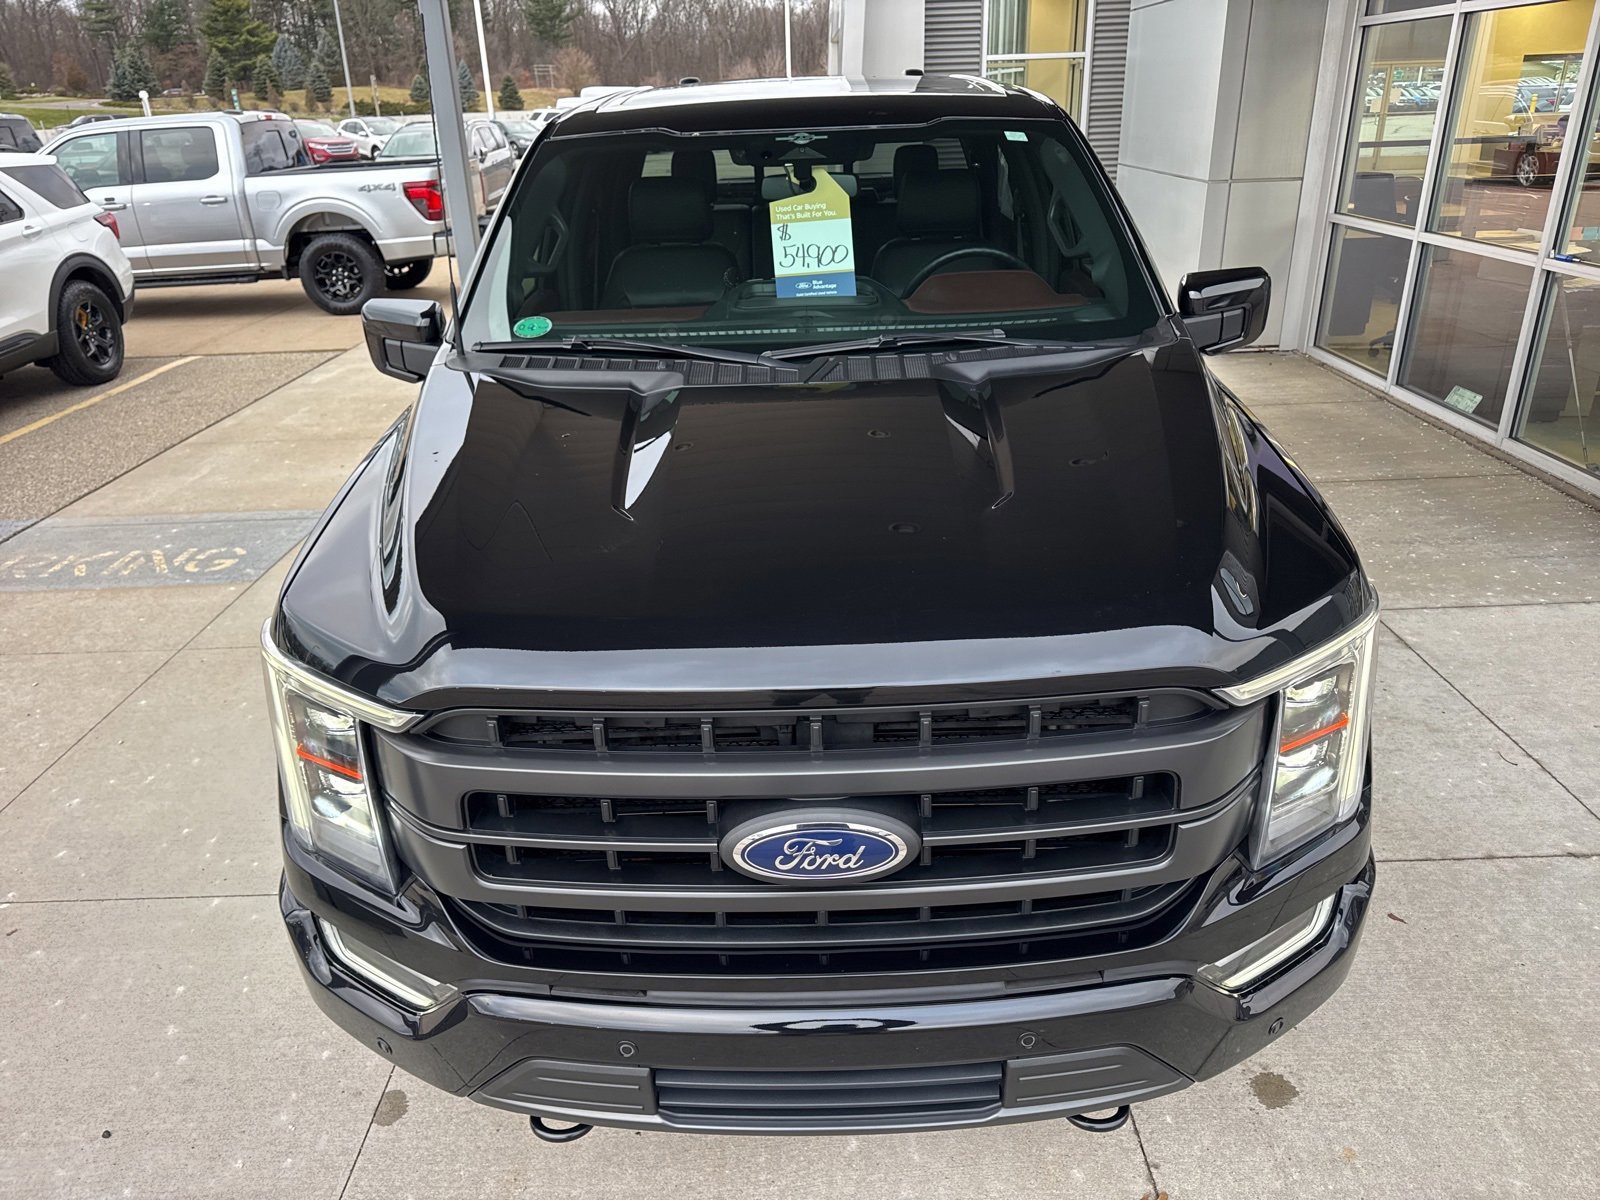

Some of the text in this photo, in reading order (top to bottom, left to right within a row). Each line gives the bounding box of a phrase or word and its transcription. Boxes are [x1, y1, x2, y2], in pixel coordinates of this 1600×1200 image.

[804, 203, 827, 211] Buying
[779, 243, 849, 269] 54,900
[774, 837, 867, 871] Ford
